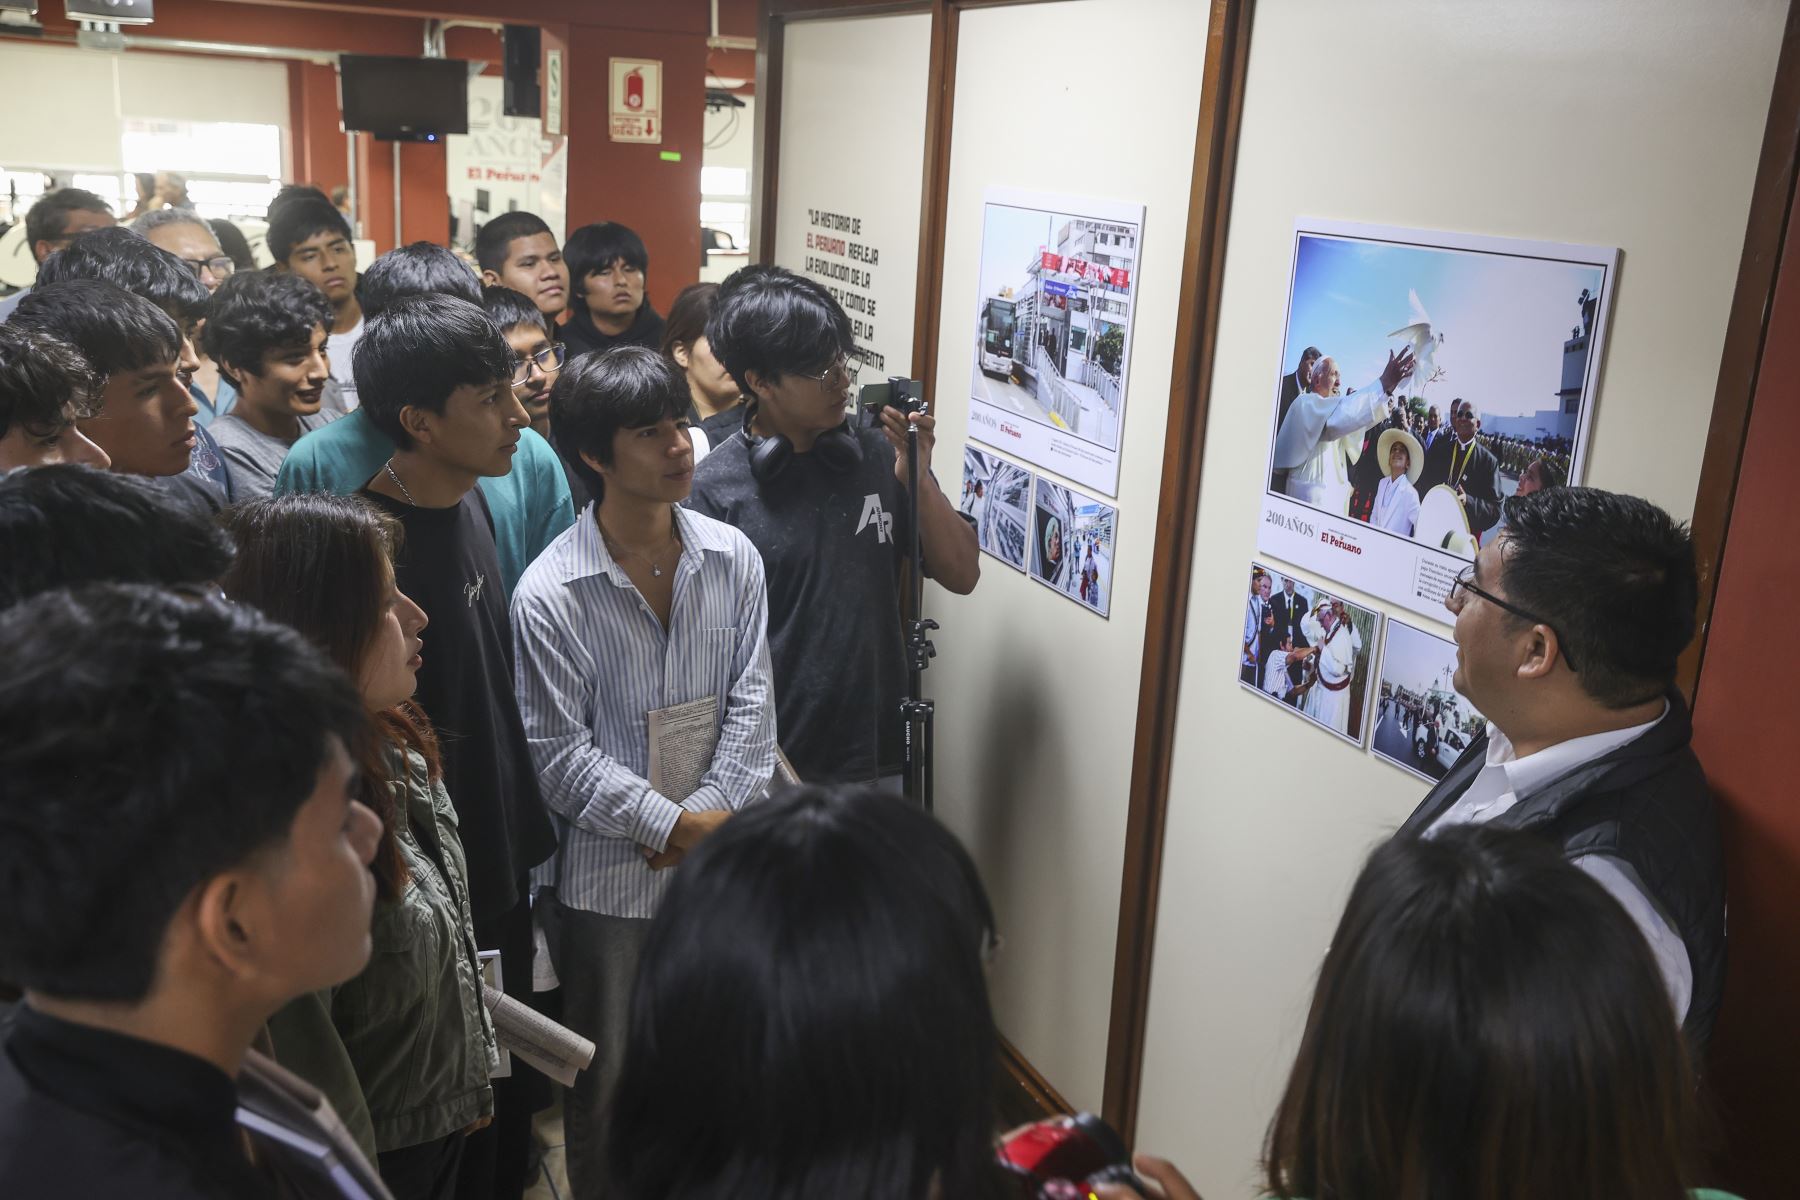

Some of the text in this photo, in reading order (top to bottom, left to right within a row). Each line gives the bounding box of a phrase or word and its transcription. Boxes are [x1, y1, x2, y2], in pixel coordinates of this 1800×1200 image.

[821, 211, 851, 233] HISTORIA
[852, 217, 861, 236] DE
[807, 232, 879, 266] EL PERUANO REFLEJA
[806, 256, 871, 289] LA EVOLUCIÓN DE LA
[840, 289, 845, 306] Y
[867, 299, 876, 317] SE
[864, 323, 874, 342] LA
[1265, 509, 1285, 527] 200
[1284, 516, 1314, 538] AÑOS
[1320, 531, 1330, 543] El
[1330, 535, 1362, 555] Peruano
